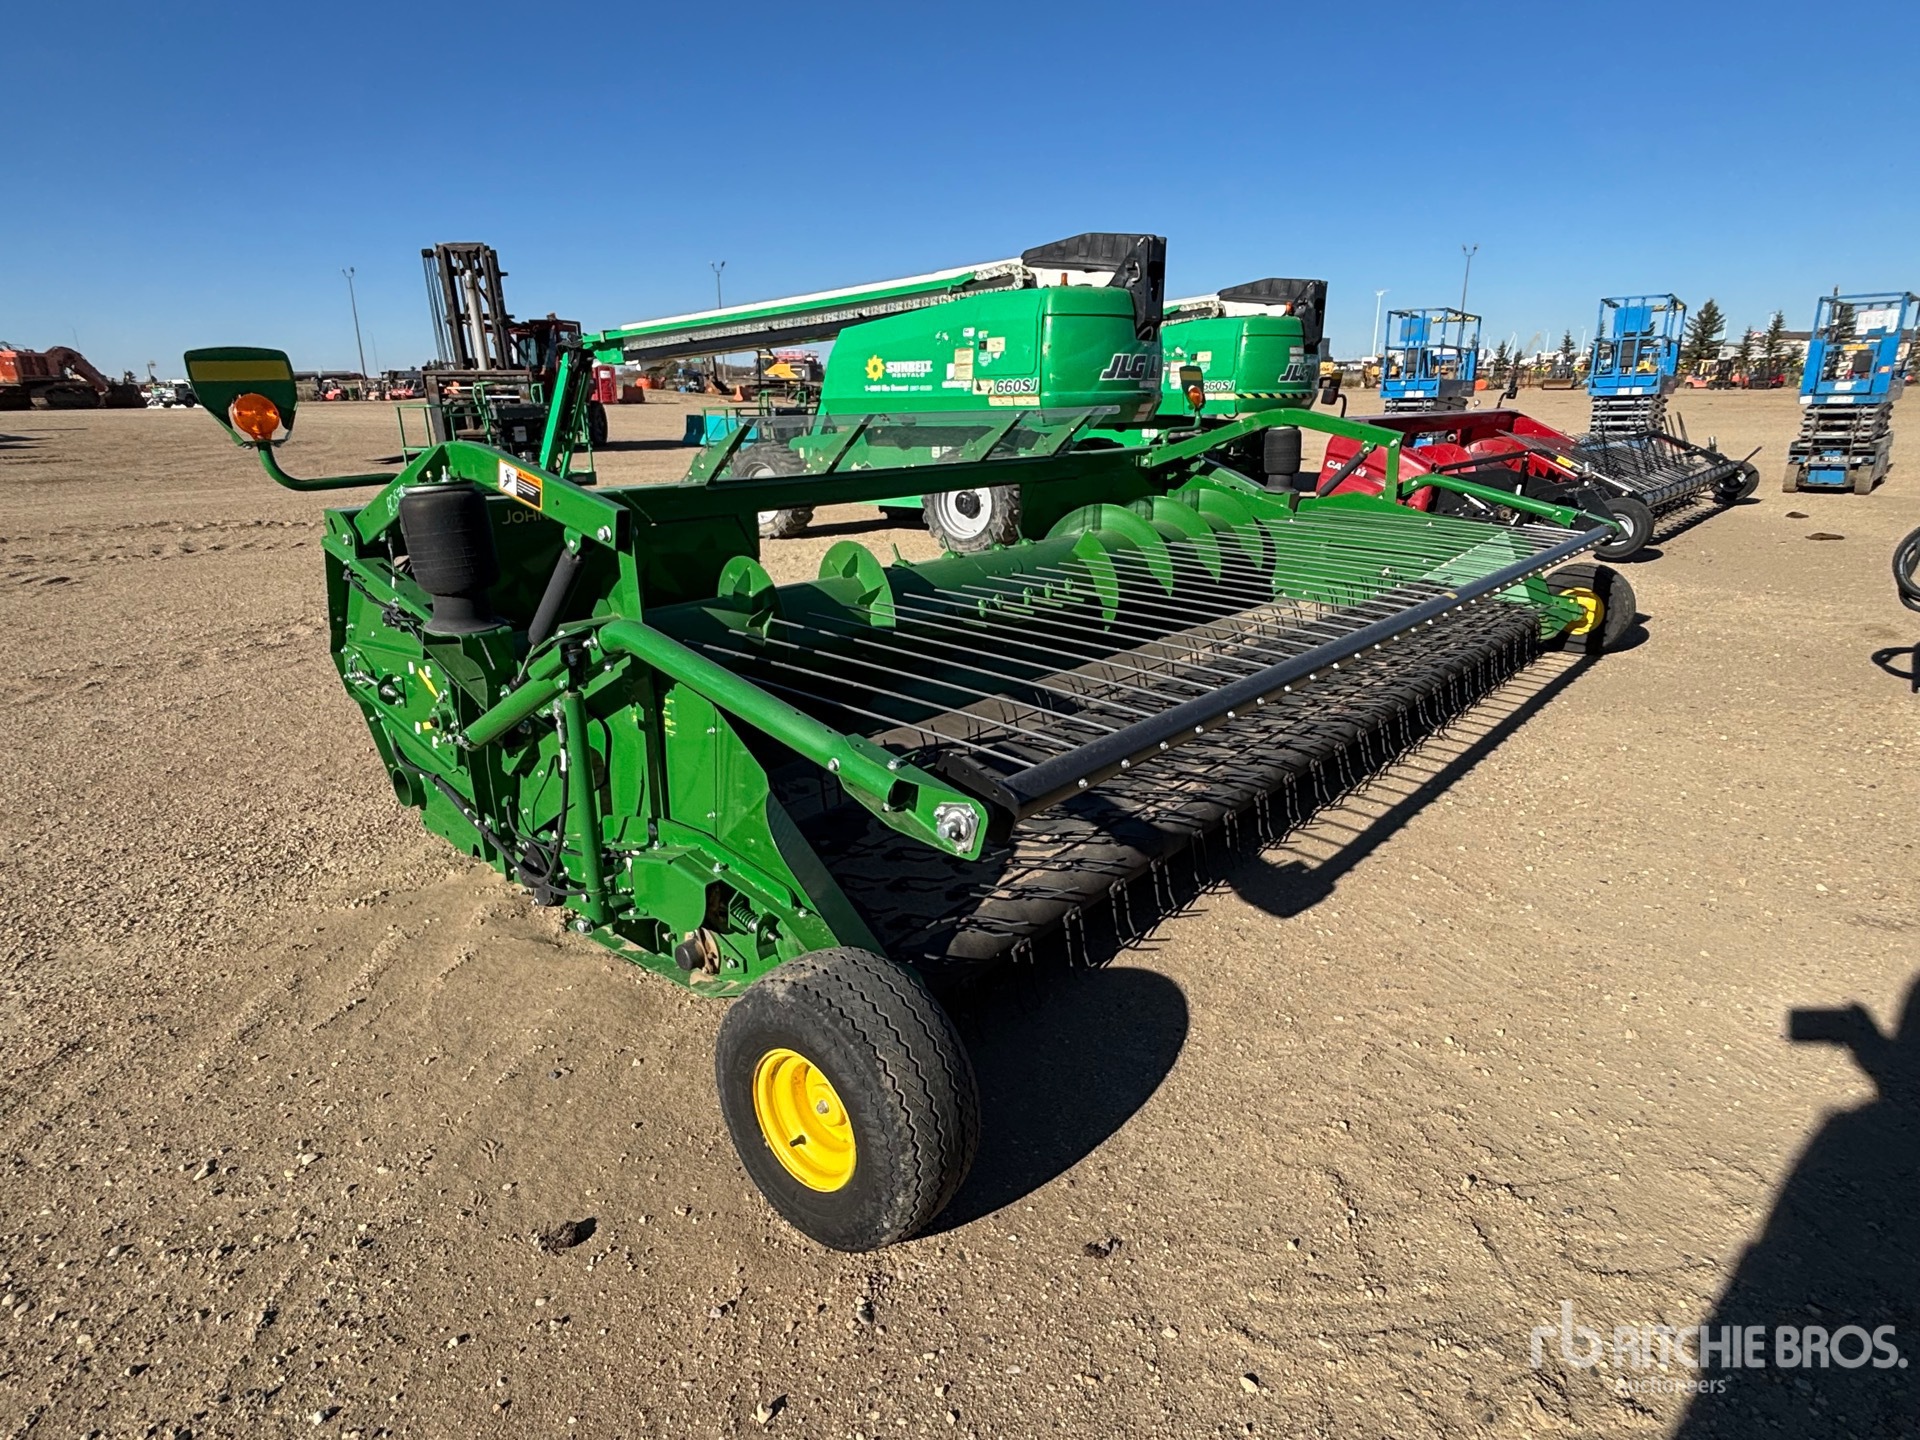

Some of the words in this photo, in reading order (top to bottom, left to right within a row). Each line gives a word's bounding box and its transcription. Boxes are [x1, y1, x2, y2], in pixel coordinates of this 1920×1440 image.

[885, 360, 933, 373] SUNBELT
[1098, 353, 1148, 381] JLG
[995, 377, 1040, 394] 660SJ
